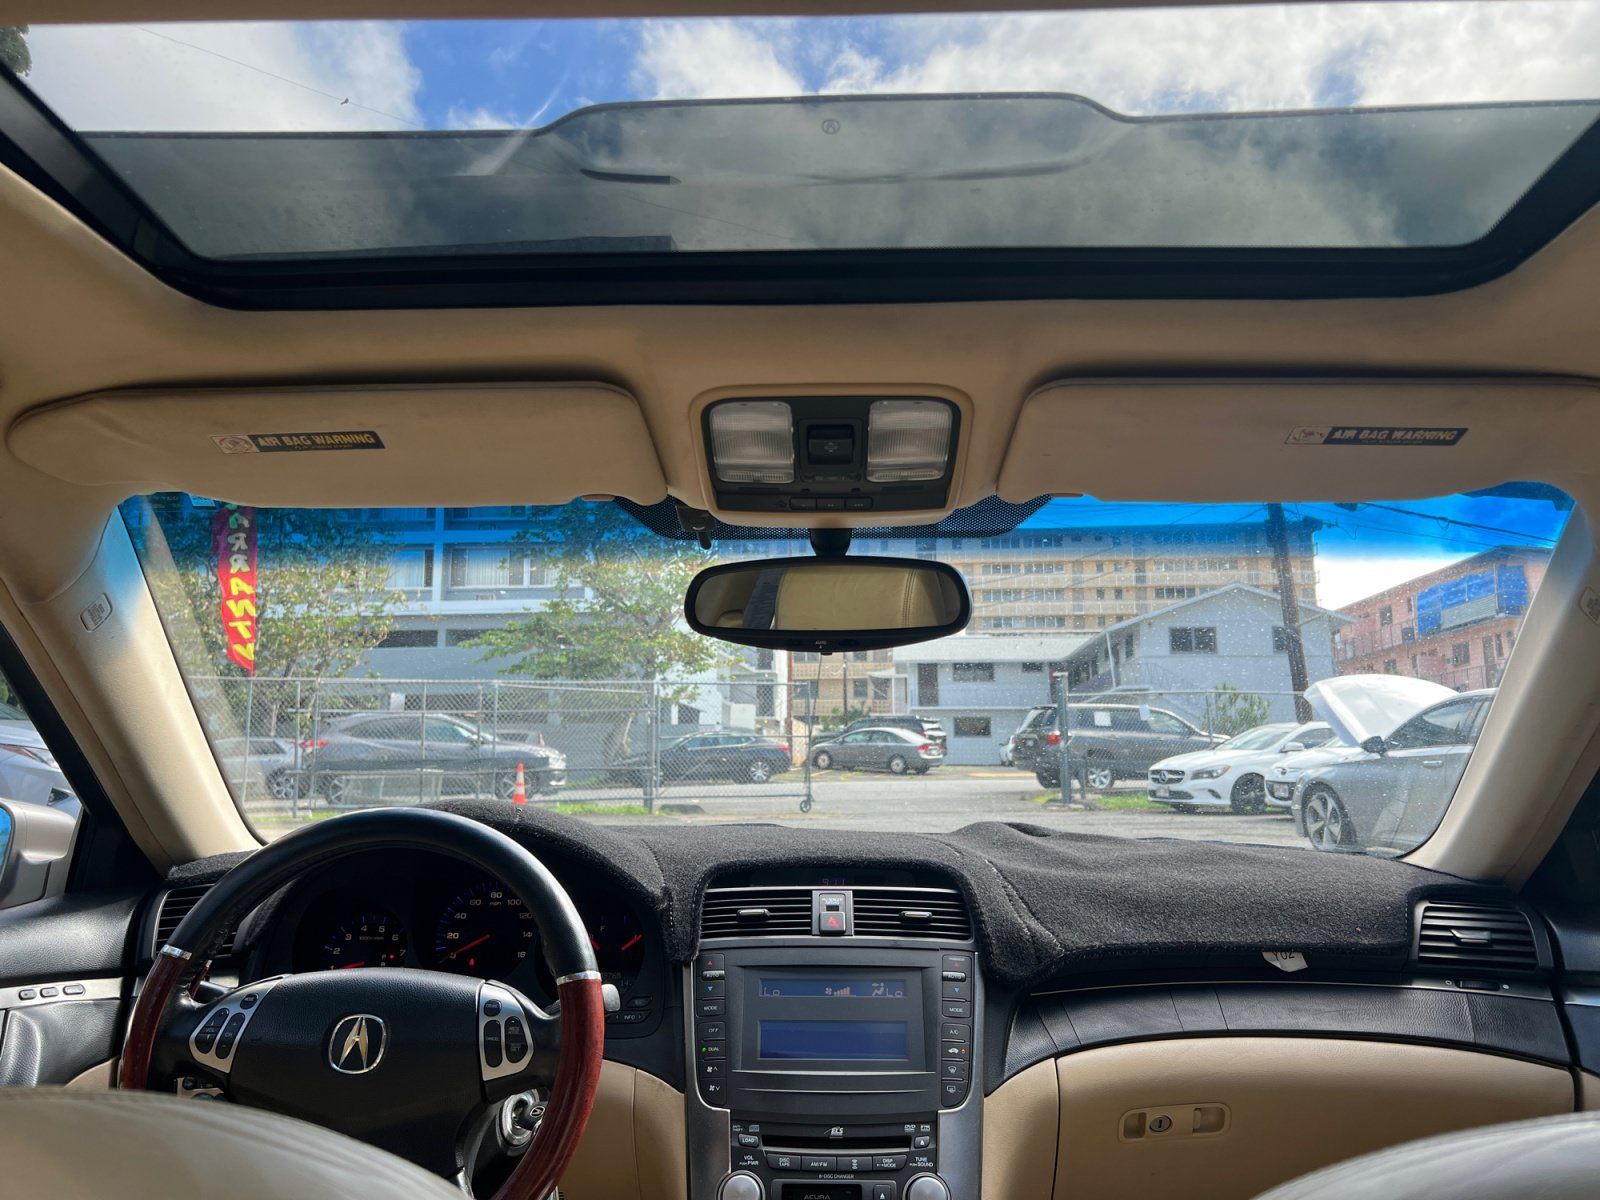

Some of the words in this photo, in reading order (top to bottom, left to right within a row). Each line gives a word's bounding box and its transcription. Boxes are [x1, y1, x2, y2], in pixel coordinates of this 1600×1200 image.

[1359, 430, 1389, 440] BAG
[1391, 430, 1458, 441] WARNING
[257, 436, 281, 447] AIR
[282, 435, 312, 446] BAG
[312, 434, 376, 445] WARNING
[490, 891, 503, 899] 80
[454, 912, 467, 920] 40
[344, 933, 353, 941] 3
[447, 932, 460, 940] 20
[332, 947, 341, 955] 2
[399, 948, 406, 957] 7
